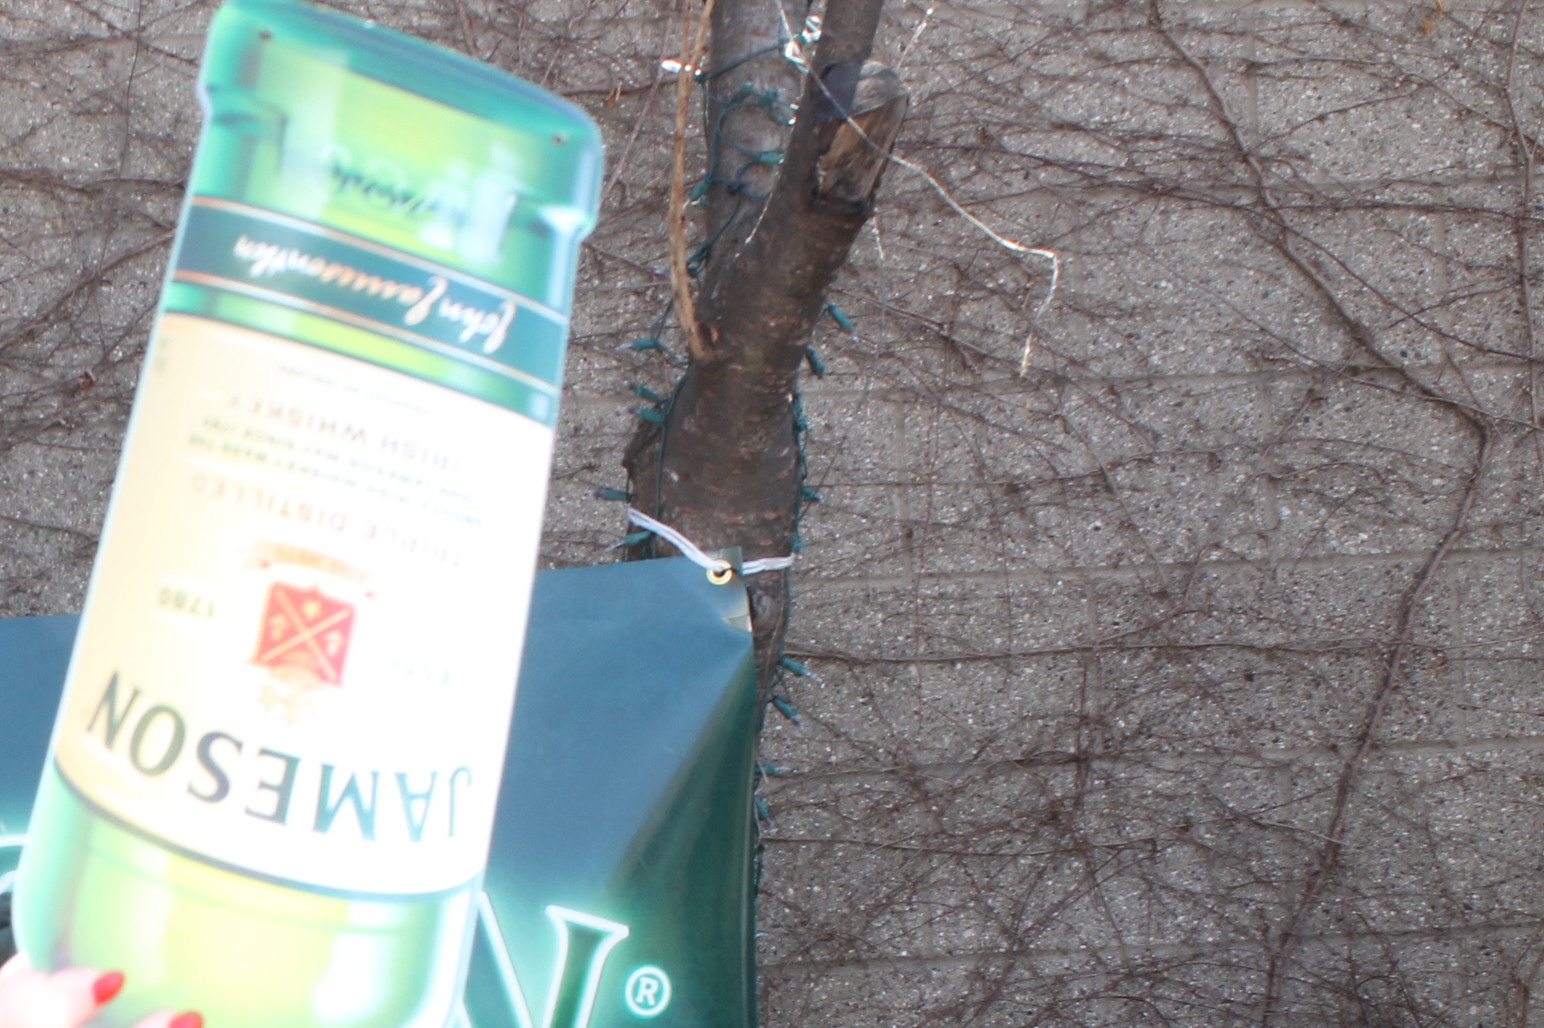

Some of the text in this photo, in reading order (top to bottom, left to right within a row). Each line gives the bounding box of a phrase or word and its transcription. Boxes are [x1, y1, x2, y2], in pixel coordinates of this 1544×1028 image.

[226, 381, 371, 435] WHISKEY
[186, 470, 349, 534] DISTILLED
[84, 667, 471, 844] JAMESON
